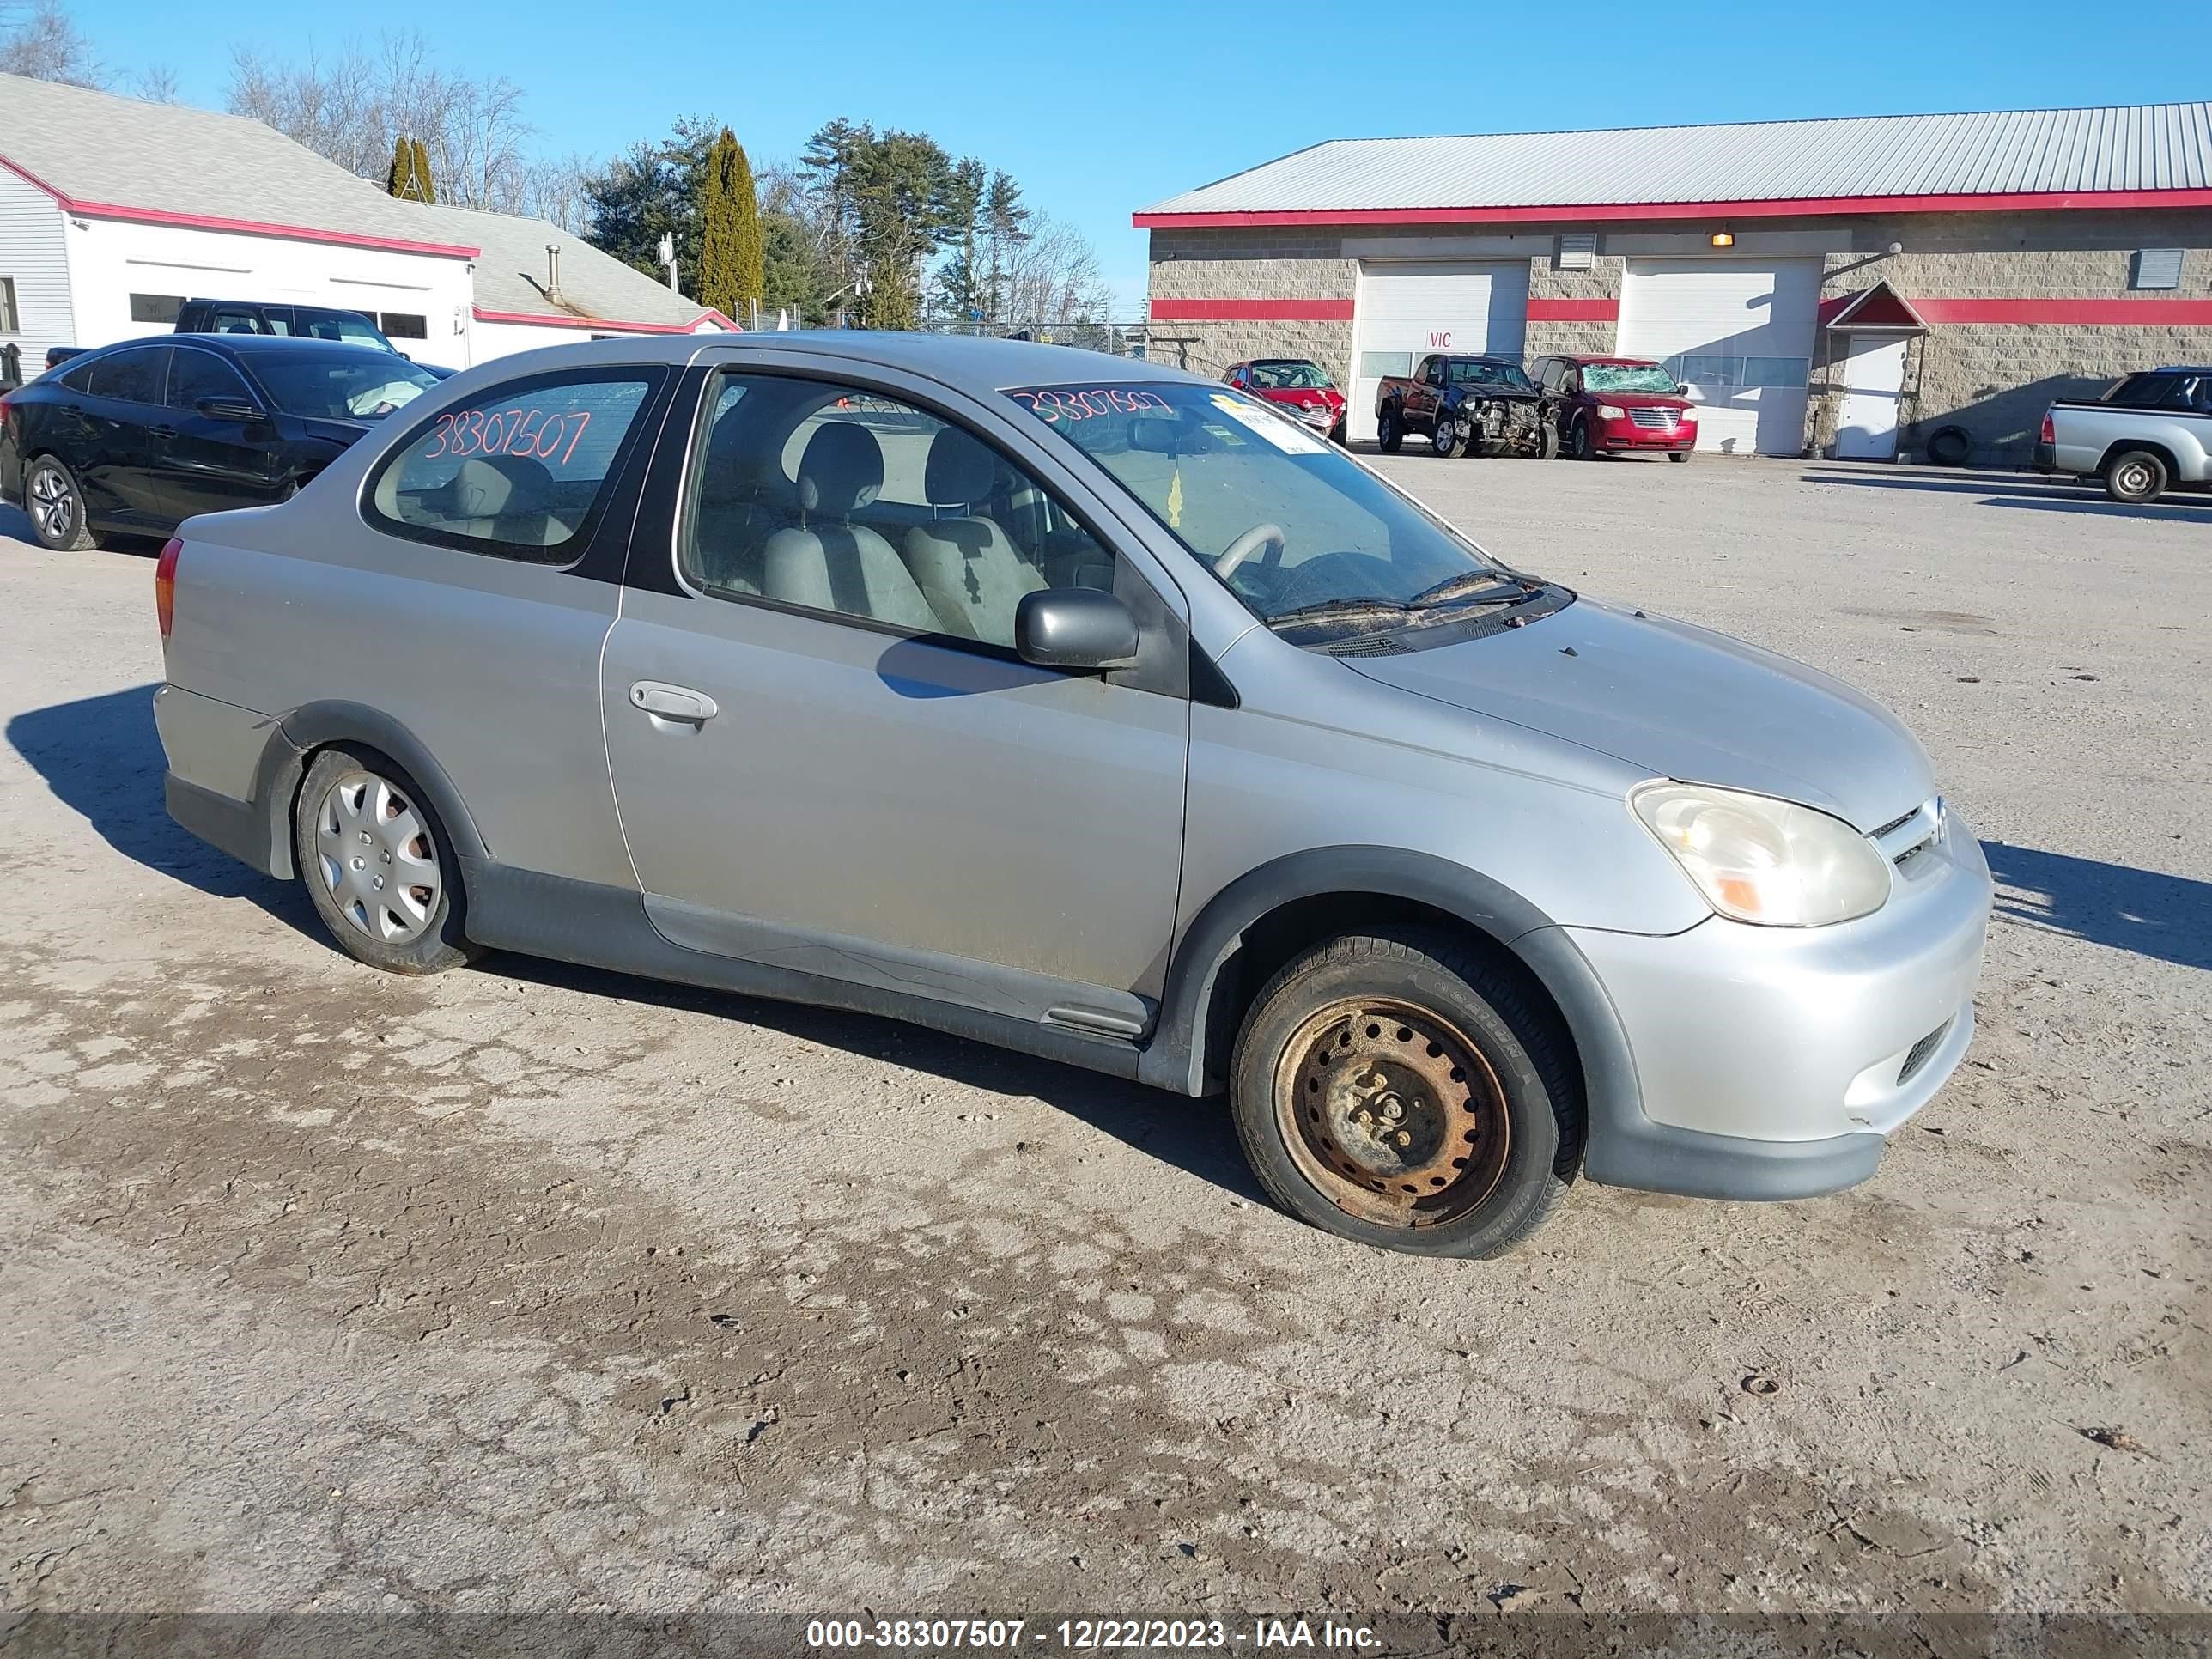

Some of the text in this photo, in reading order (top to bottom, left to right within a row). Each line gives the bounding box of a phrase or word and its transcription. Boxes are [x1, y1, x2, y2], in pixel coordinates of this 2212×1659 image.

[1430, 331, 1452, 348] VIC
[1012, 390, 1174, 422] 38307507
[424, 408, 592, 466] 38307507
